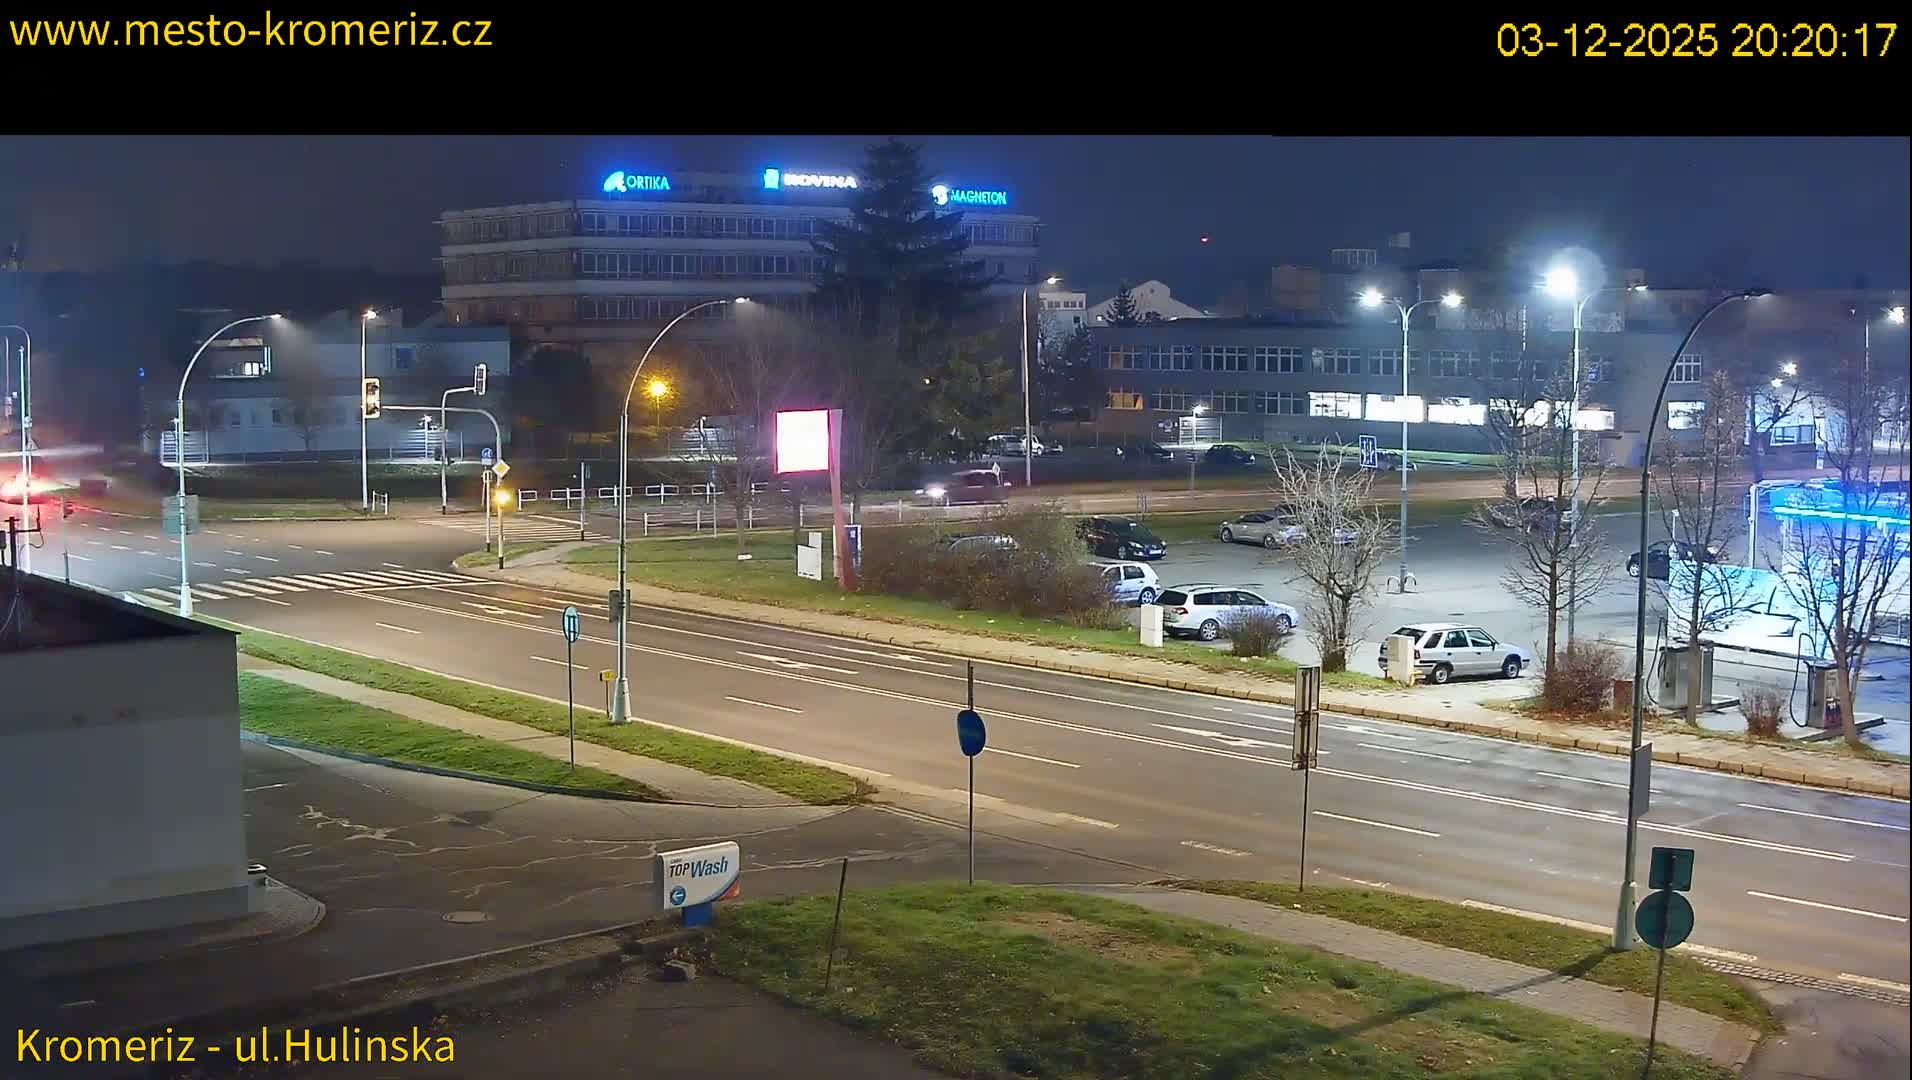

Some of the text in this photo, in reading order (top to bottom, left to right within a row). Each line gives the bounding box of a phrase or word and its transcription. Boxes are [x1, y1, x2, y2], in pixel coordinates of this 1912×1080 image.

[626, 175, 671, 190] ORTIKA
[950, 189, 1007, 205] MAGNETON
[670, 856, 728, 878] TOP Wash
